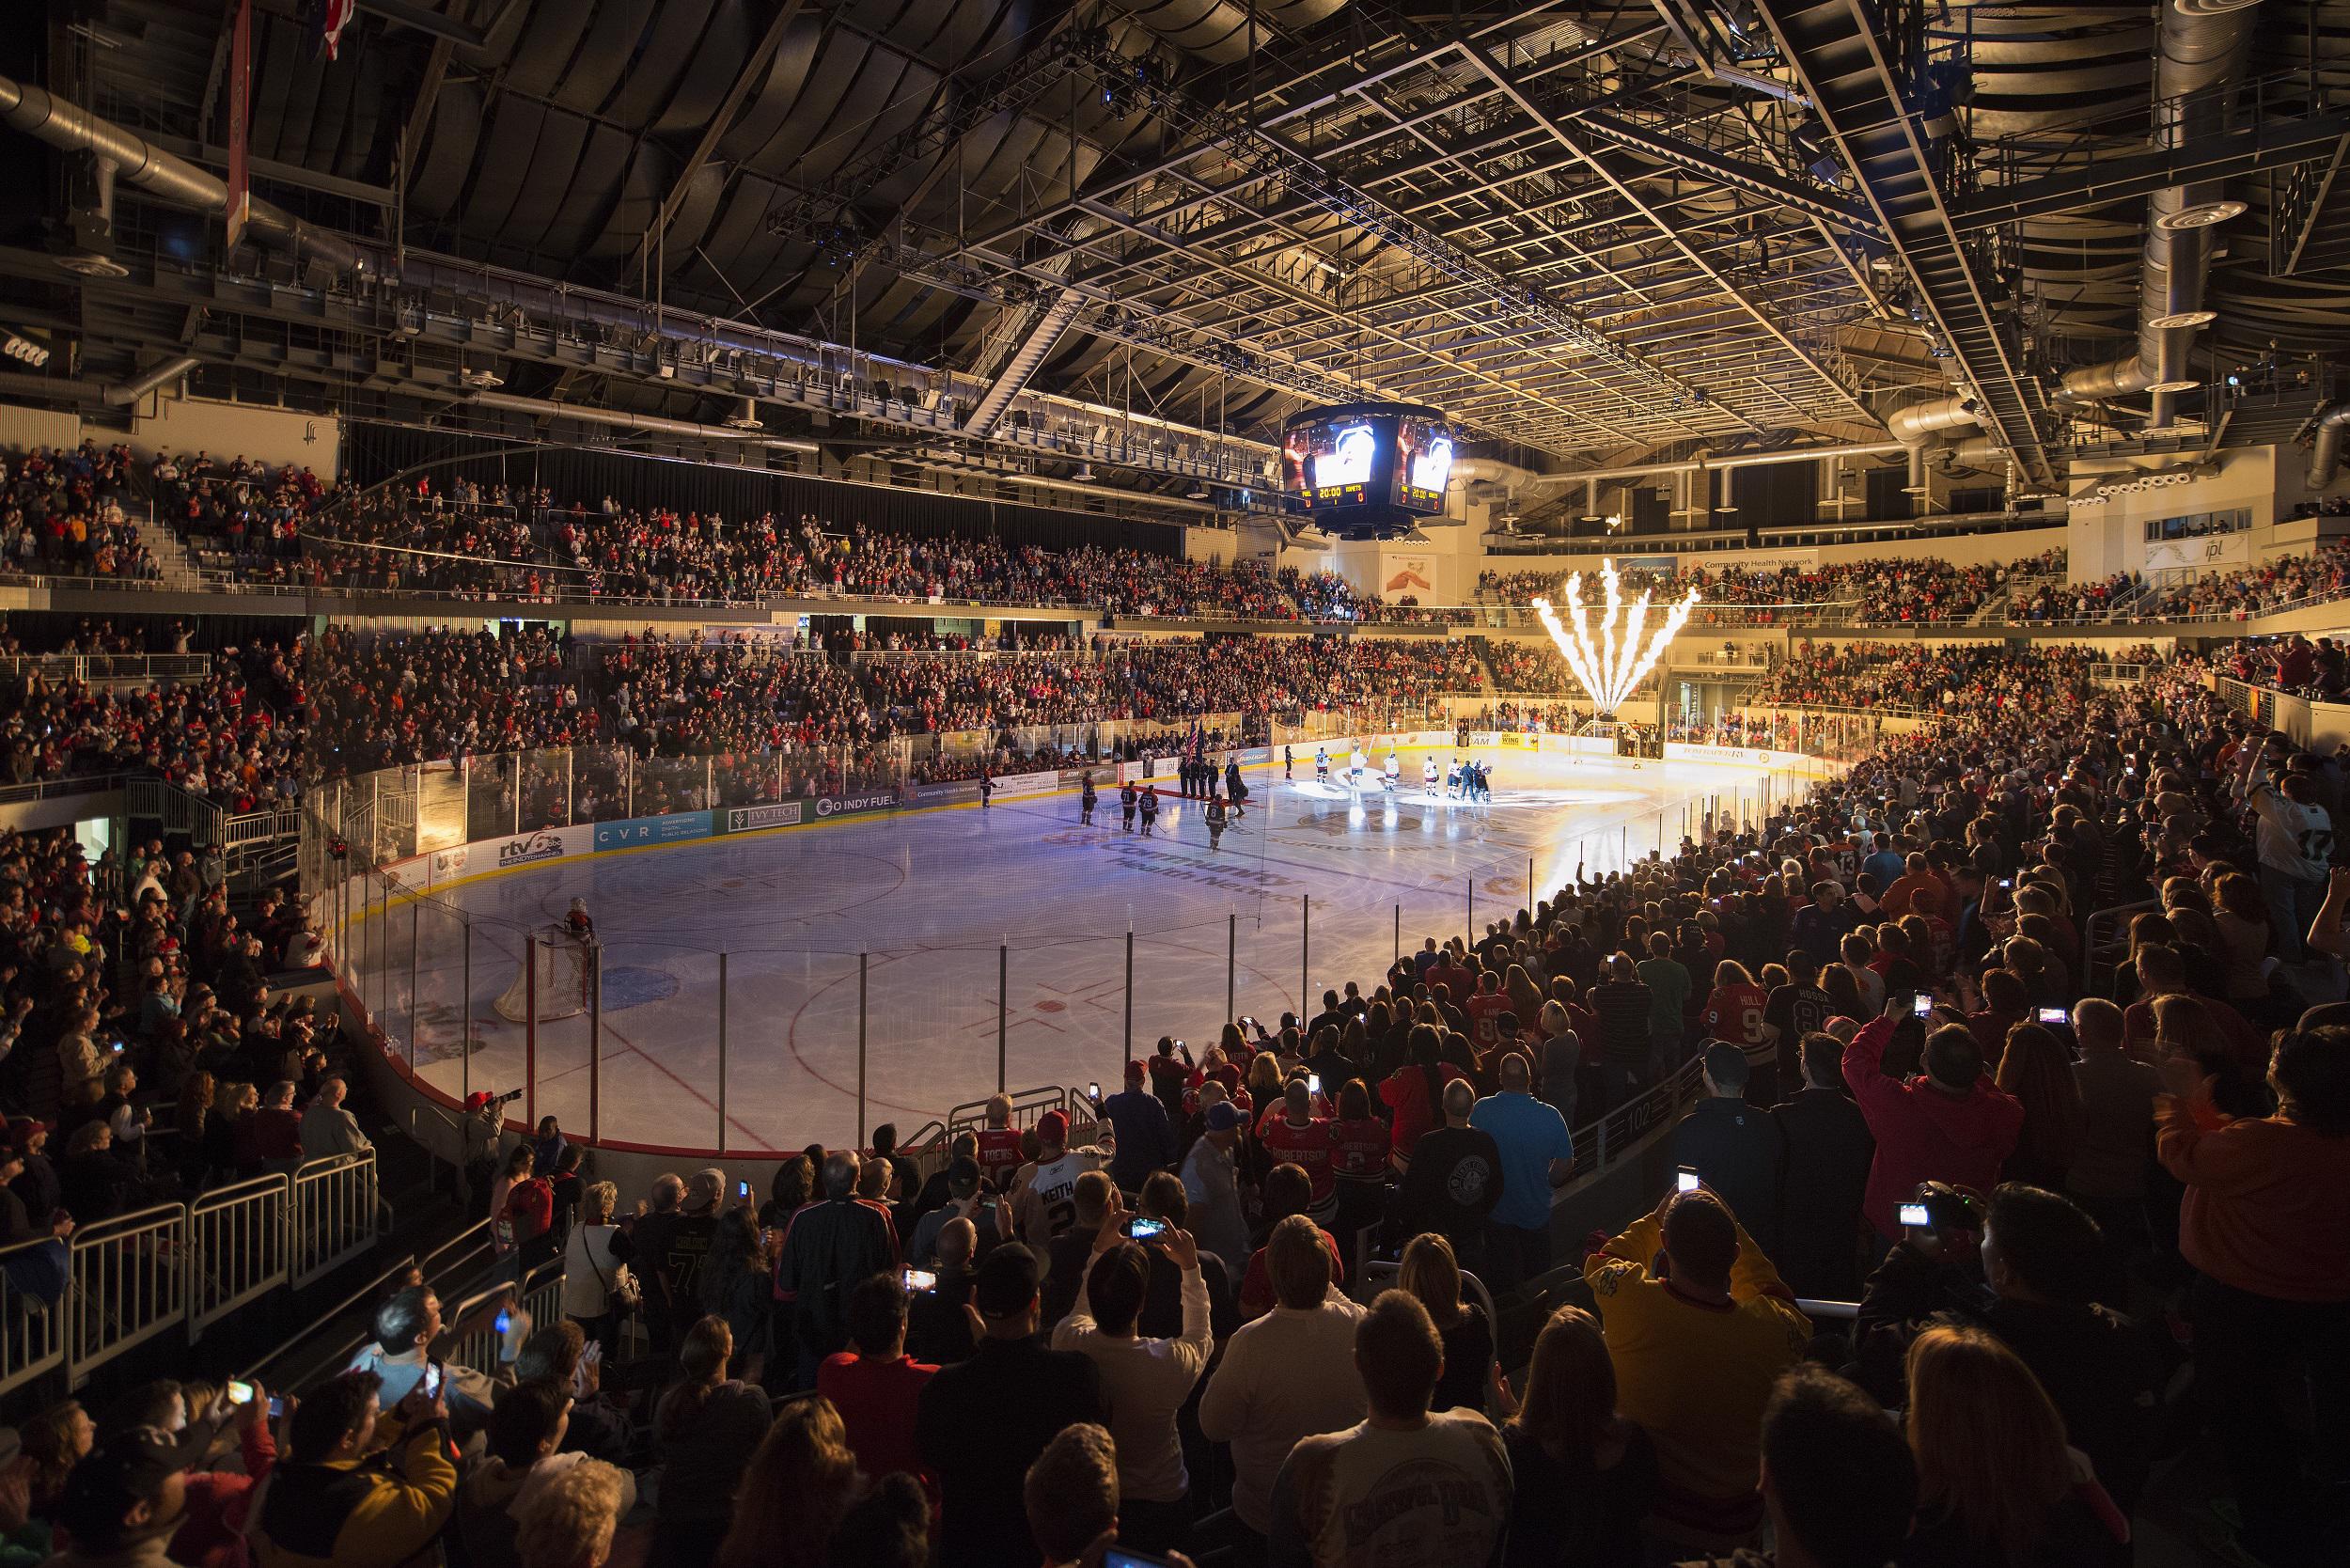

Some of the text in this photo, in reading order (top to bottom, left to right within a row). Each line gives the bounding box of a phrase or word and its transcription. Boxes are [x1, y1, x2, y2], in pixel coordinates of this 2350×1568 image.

[1319, 487, 1340, 498] 20:00
[2205, 540, 2223, 562] ipl
[1704, 557, 1812, 569] Community Health Network
[916, 790, 944, 798] Community
[1122, 792, 1130, 801] 71
[816, 795, 896, 816] GO INDY FUEL
[1142, 797, 1152, 808] 79
[752, 807, 797, 821] IVY TECH
[1211, 808, 1216, 818] 8
[1100, 842, 1308, 887] Community
[1839, 855, 1855, 875] 13
[1739, 995, 1762, 1006] HULL
[1798, 988, 1829, 1003] HOSSA
[1708, 1011, 1718, 1024] 9
[1742, 1008, 1763, 1043] 9
[1627, 1101, 1652, 1135] 102
[983, 1148, 1012, 1162] TOEWS
[1272, 1146, 1327, 1162] ROBERTSON
[1041, 1180, 1073, 1205] KEITH
[1048, 1199, 1075, 1237] 2
